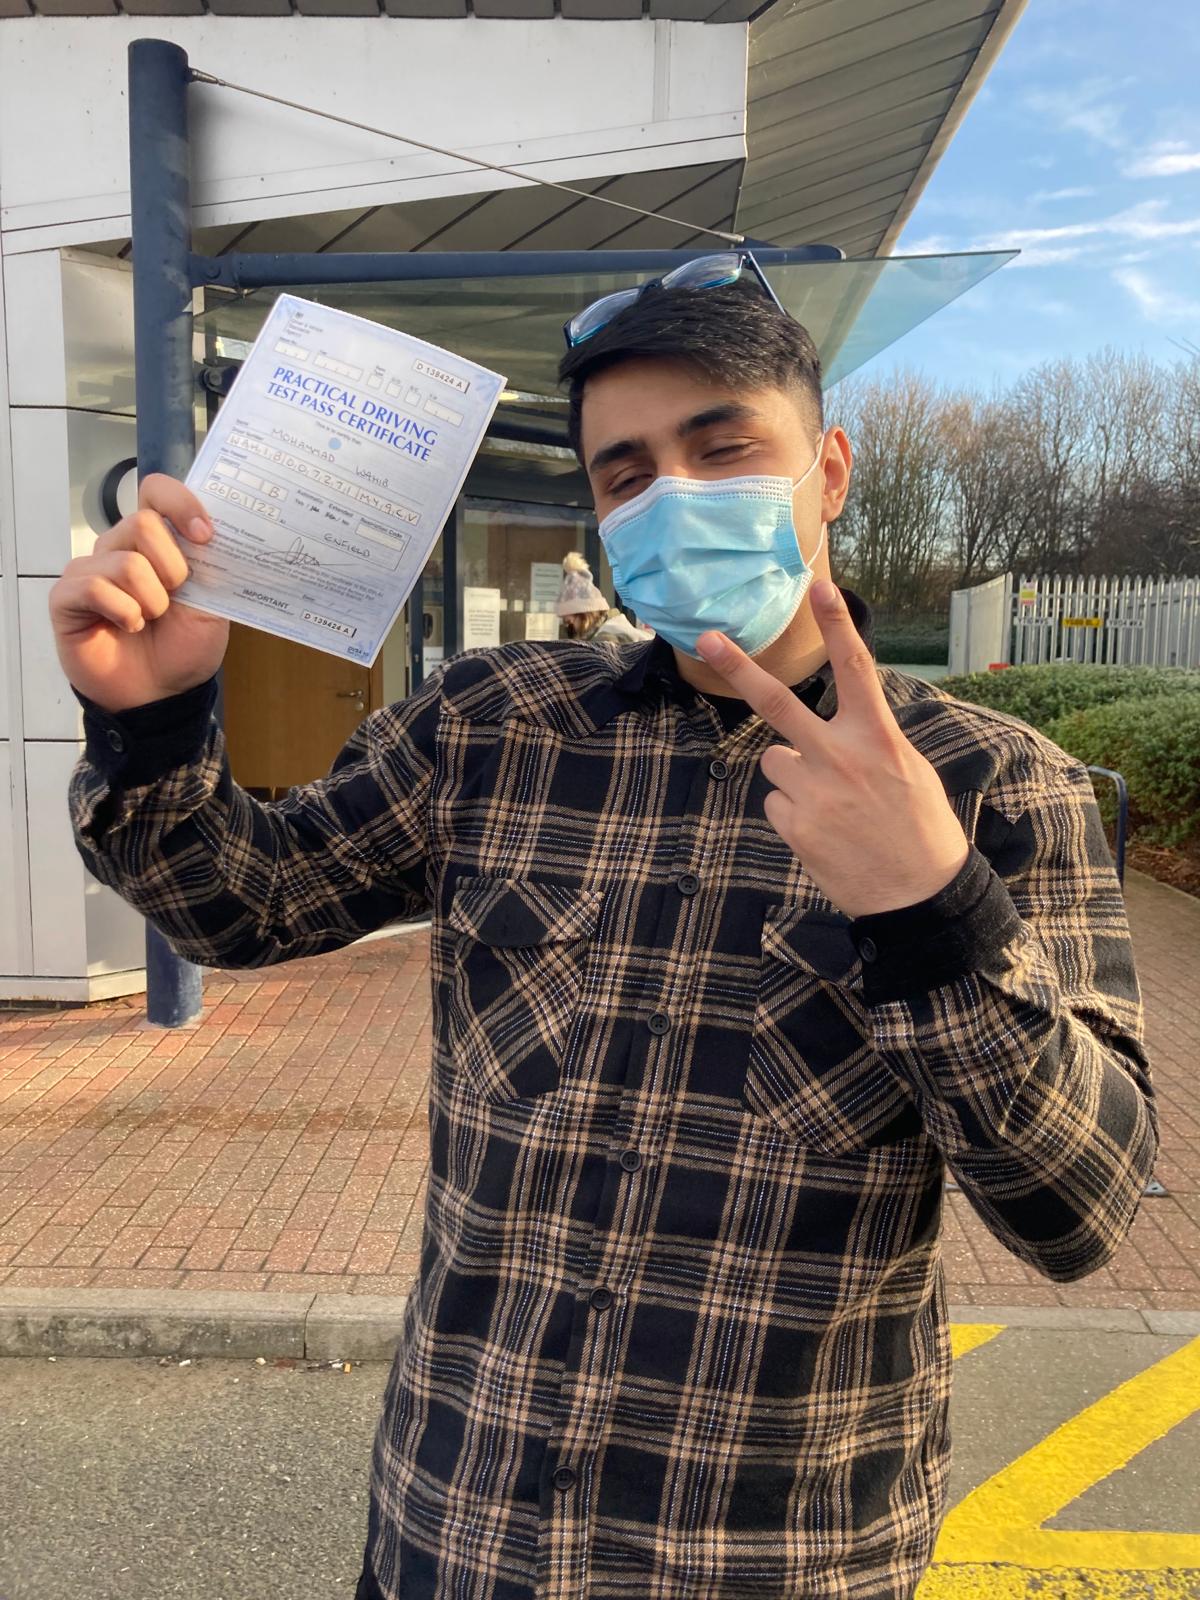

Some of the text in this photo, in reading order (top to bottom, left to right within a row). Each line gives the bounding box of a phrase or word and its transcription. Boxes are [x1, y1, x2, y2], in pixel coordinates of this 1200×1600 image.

[415, 362, 424, 370] D
[455, 380, 463, 388] A
[273, 365, 438, 446] PRACTICAL DRIVING
[266, 381, 432, 461] TEST PASS CERTIFICATE
[242, 587, 289, 610] IMPORTANT
[303, 612, 311, 620] D
[342, 626, 350, 634] A
